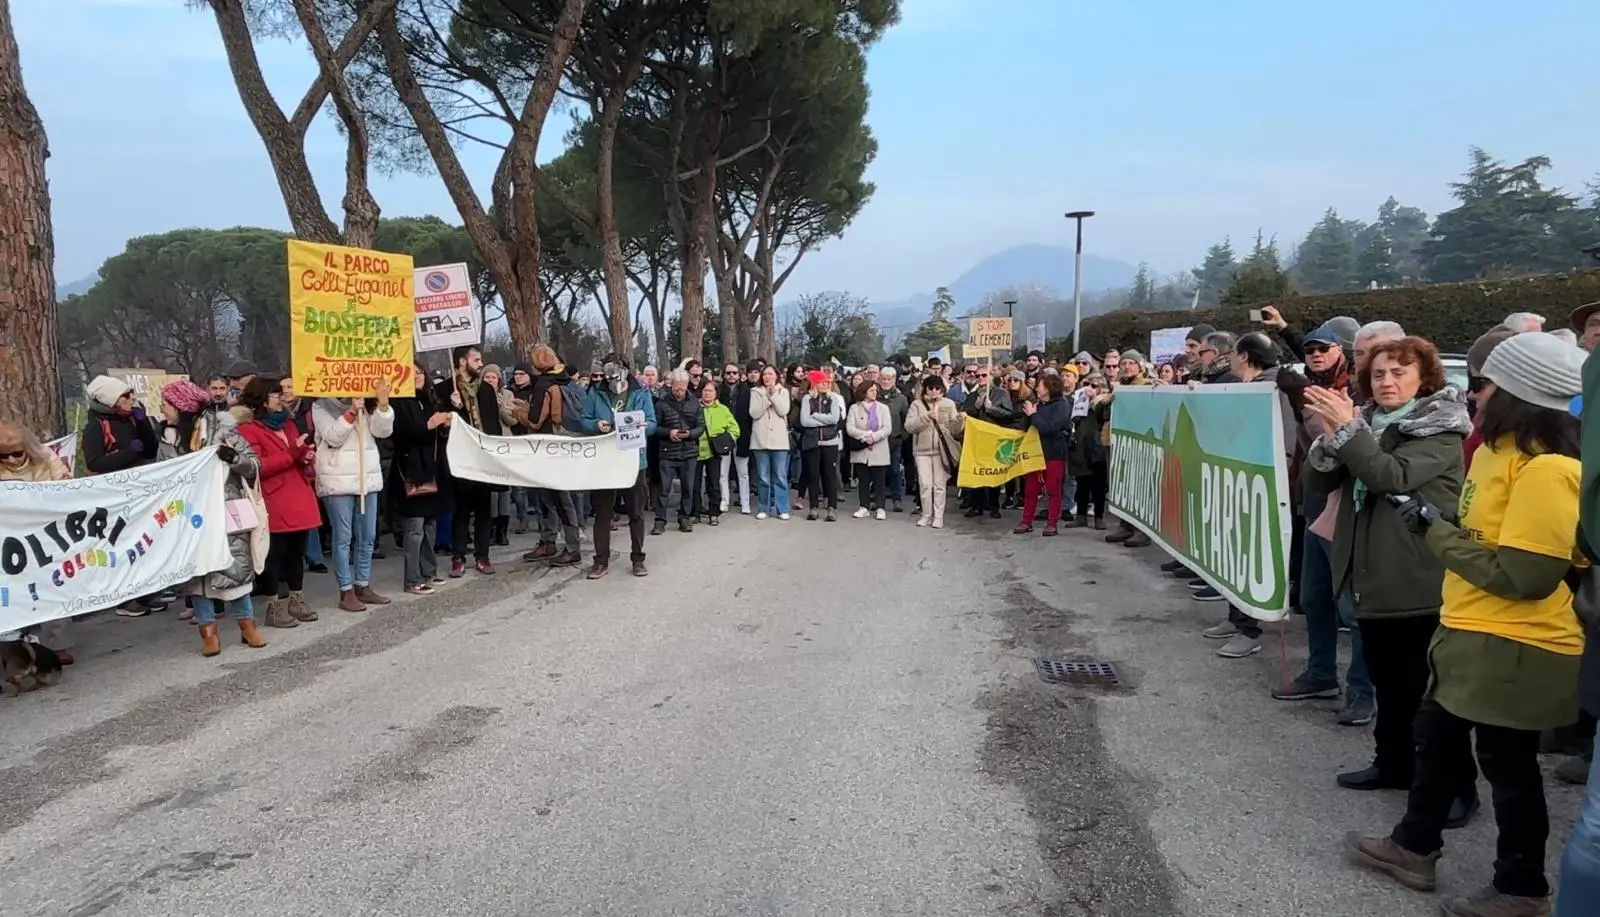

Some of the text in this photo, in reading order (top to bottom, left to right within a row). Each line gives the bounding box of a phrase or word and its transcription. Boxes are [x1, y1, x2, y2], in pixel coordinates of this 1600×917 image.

[324, 252, 389, 274] IL PARCO
[301, 269, 409, 305] Colli Euganei
[415, 292, 466, 305] LASCIARE LIBERO
[428, 299, 463, 310] PAESAGGIO
[304, 306, 401, 339] BIOSFERA
[977, 320, 1006, 331] STOP
[324, 335, 394, 359] UNESCO
[970, 333, 1011, 346] AL CEMENTO
[319, 362, 393, 377] A QUALCUNO
[478, 434, 597, 459] La Vespa
[2, 507, 126, 575] OLIBRI
[1188, 492, 1199, 560] IL
[1201, 462, 1276, 603] PARCO
[52, 548, 116, 587] COLORI
[126, 532, 154, 566] DEL
